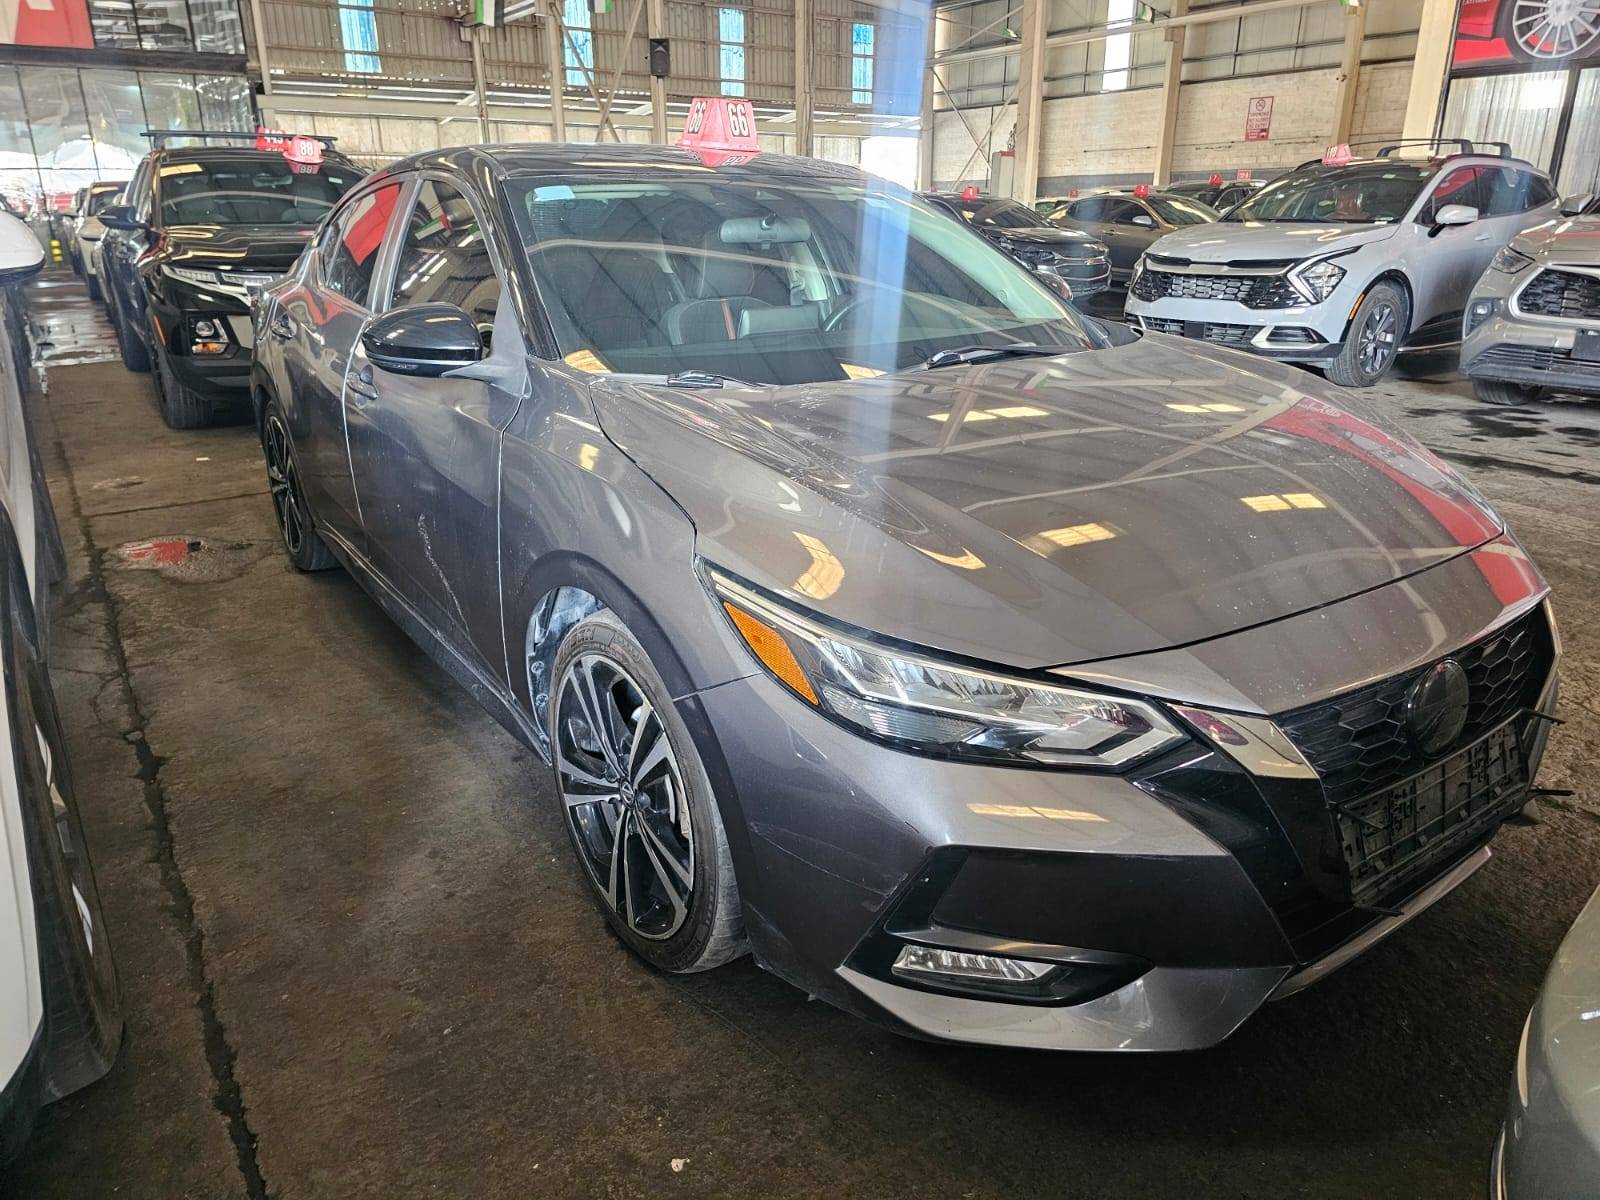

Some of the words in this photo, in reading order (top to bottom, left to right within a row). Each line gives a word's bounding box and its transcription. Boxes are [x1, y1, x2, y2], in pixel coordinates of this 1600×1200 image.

[688, 101, 706, 133] 66
[727, 103, 750, 137] 66
[300, 140, 313, 156] 88
